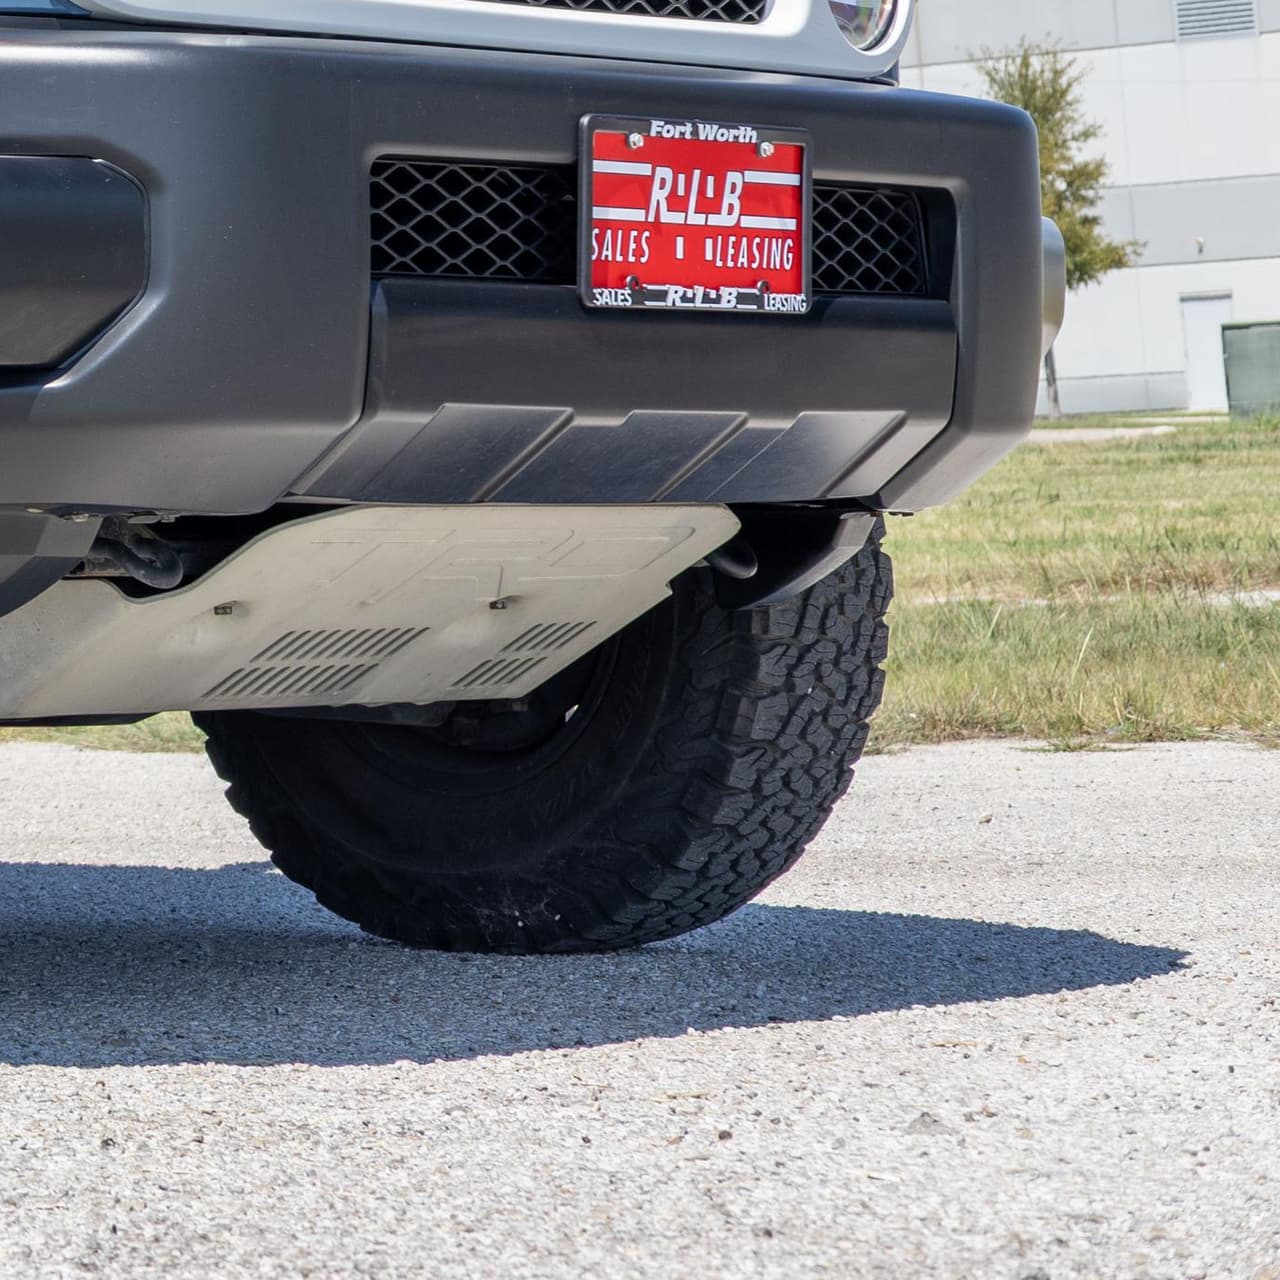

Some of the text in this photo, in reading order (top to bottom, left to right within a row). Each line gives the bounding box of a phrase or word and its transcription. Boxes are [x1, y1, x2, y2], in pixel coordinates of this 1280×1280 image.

[650, 120, 759, 144] Fort Worth
[591, 228, 794, 270] SALES LEASING
[592, 288, 632, 307] SALES
[763, 292, 807, 312] LEASING
